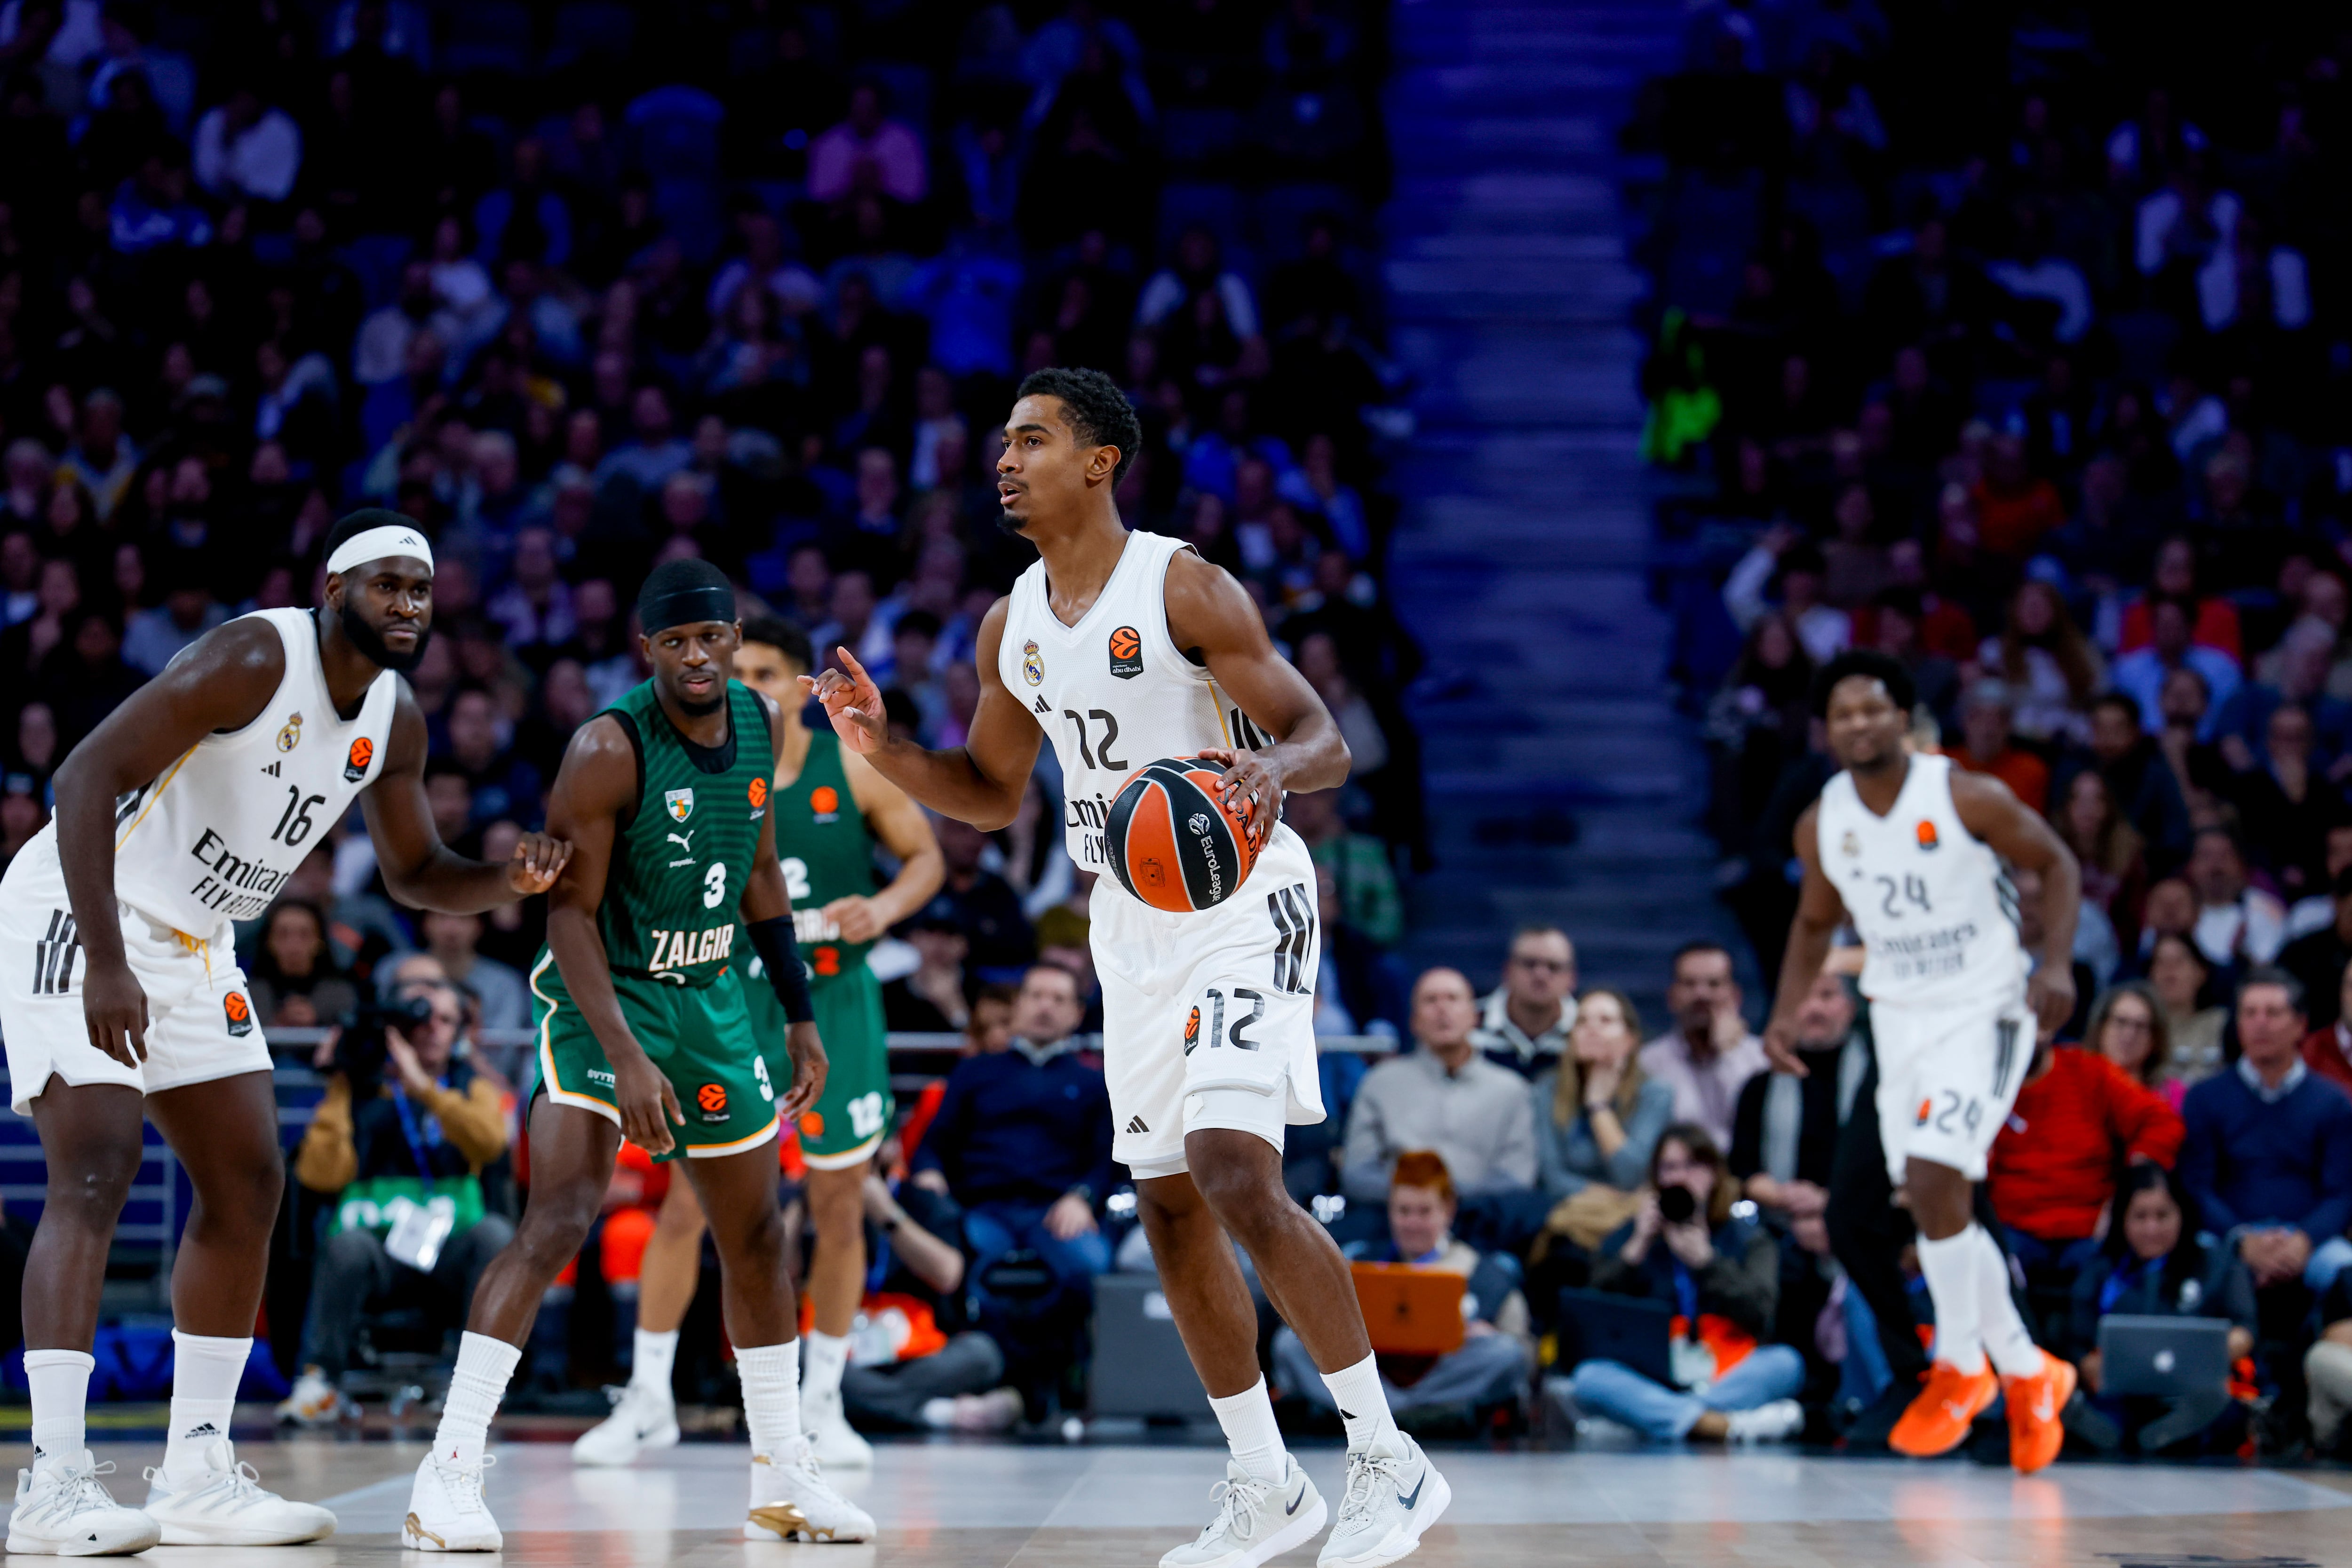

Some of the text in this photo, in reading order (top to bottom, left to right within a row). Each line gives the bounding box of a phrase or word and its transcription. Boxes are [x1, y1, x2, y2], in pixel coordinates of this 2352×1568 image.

[1064, 709, 1128, 771] 12
[271, 784, 326, 846] 16
[1085, 834, 1104, 863] FLY
[1200, 835, 1222, 902] EuroLeague
[191, 876, 233, 910] FLY
[704, 862, 726, 909] 3
[1875, 873, 1931, 917] 24
[1207, 988, 1265, 1051] 12
[754, 1055, 774, 1102] 3
[847, 1091, 884, 1139] 12
[1935, 1088, 1983, 1143] 24
